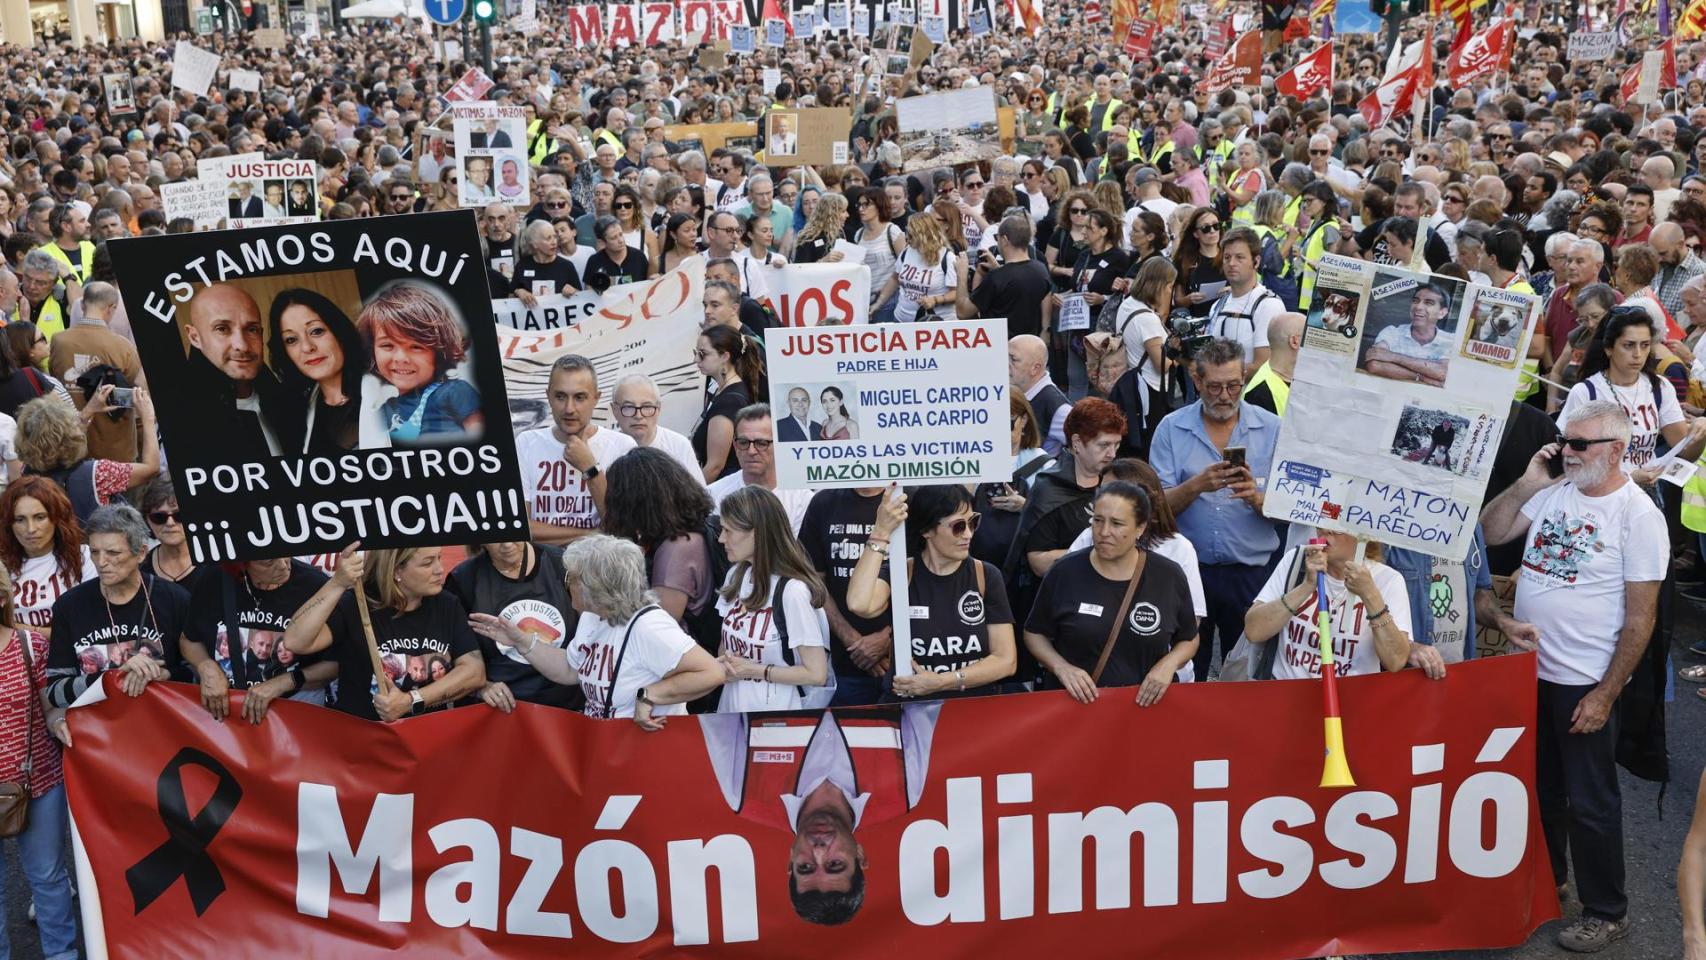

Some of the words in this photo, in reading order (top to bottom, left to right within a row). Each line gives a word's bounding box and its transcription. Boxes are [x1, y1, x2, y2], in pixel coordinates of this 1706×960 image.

[453, 107, 485, 119] VICTIMAS
[226, 162, 314, 179] JUSTICIA
[143, 231, 335, 323] ESTAMOS
[352, 232, 471, 285] AQUÍ
[914, 326, 992, 351] PARA
[1471, 342, 1511, 360] MAMBO
[836, 360, 886, 373] PADRE
[890, 359, 898, 371] E
[904, 357, 938, 371] HIJA
[860, 388, 923, 406] MIGUEL
[926, 386, 991, 404] CARPIO
[994, 385, 1005, 402] Y
[877, 411, 924, 429] SARA
[926, 408, 989, 426] CARPIO
[792, 448, 803, 461] Y
[806, 446, 868, 460] TODAS
[872, 443, 908, 457] LAS
[912, 440, 994, 456] VICTIMAS
[185, 461, 270, 497] POR
[281, 444, 503, 487] VOSOTROS
[806, 459, 883, 480] MAZÓN
[887, 457, 981, 477] DIMISIÓN
[1275, 478, 1330, 501] RATA
[536, 495, 551, 513] NI
[555, 495, 593, 513] OBLIT
[1295, 499, 1318, 513] MAL
[1390, 506, 1415, 519] AL
[247, 488, 523, 549] JUSTICIA!!!
[846, 523, 864, 535] UNA
[838, 566, 848, 578] DE
[530, 602, 561, 627] JUSTICIA
[1288, 620, 1306, 644] NI
[421, 637, 450, 656] AQUÍ
[911, 634, 983, 657] SARA
[295, 782, 759, 946] Mazón
[899, 727, 1530, 926] dimissió
